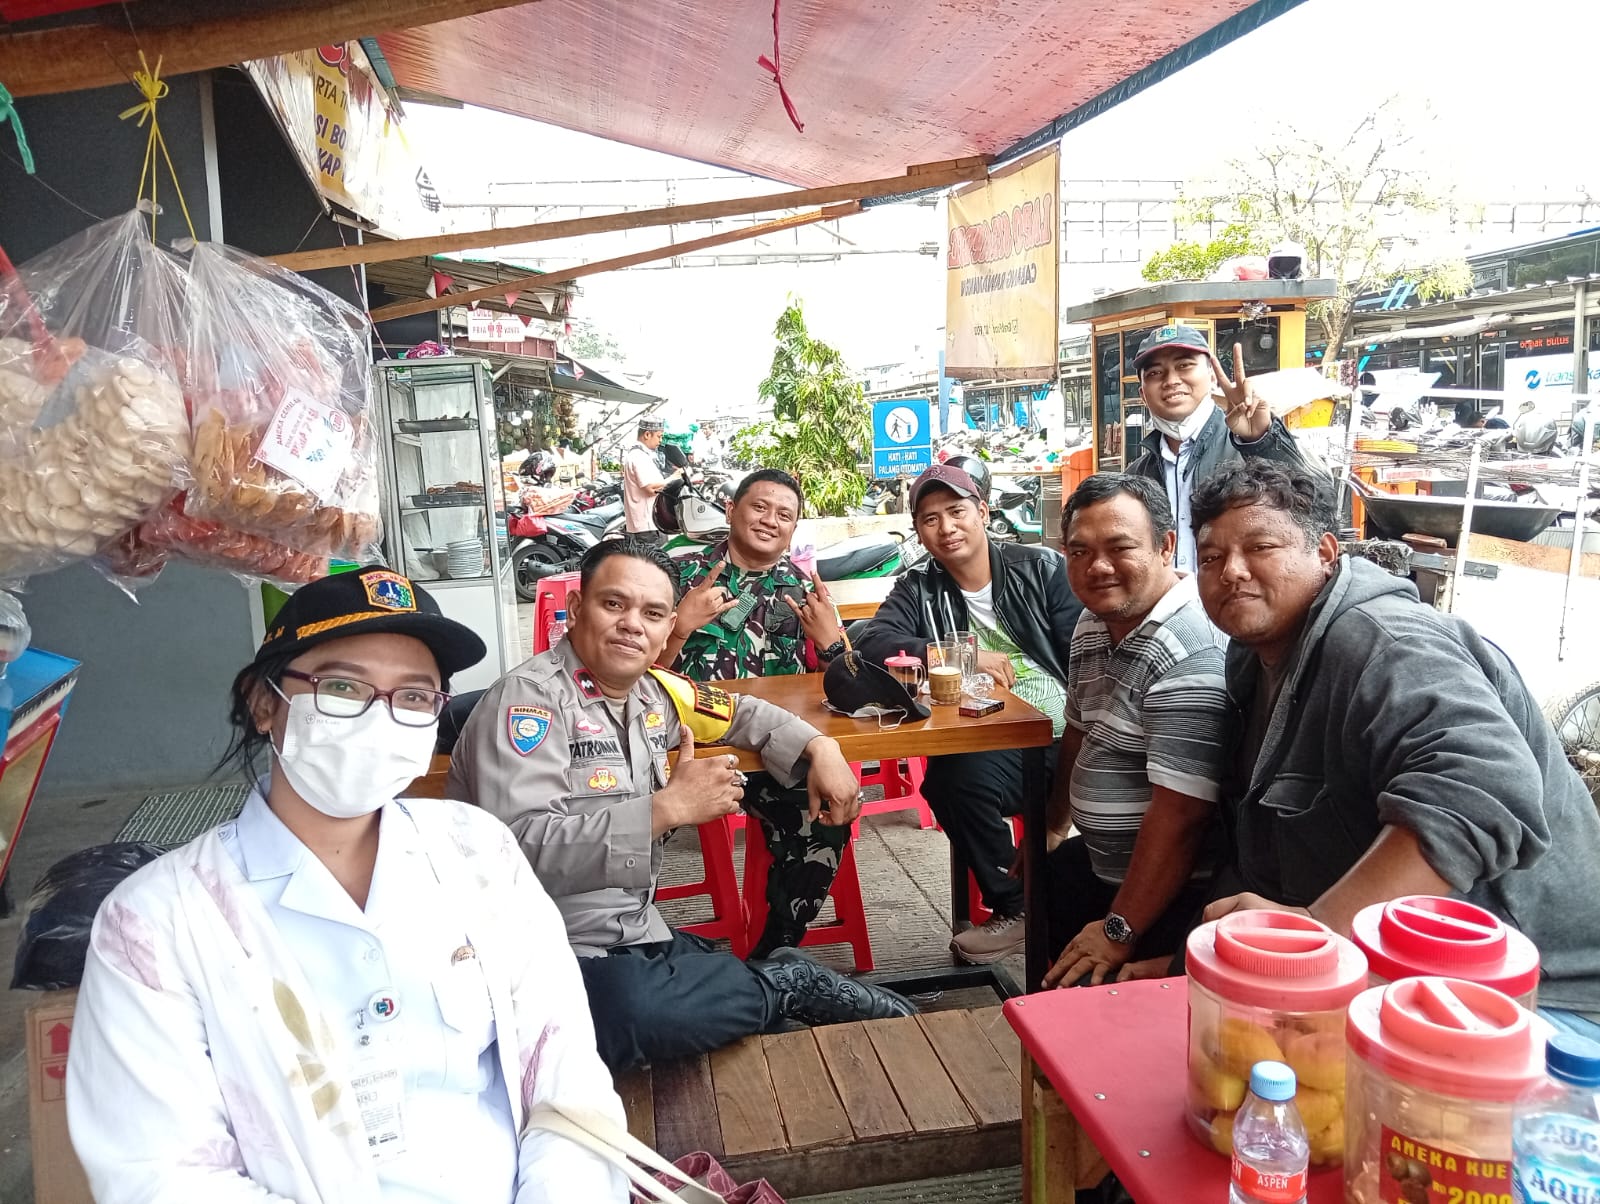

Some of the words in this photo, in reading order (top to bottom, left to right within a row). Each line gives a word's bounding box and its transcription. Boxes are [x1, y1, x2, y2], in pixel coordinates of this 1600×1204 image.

[887, 452, 900, 462] HATI
[904, 451, 917, 461] HATI
[878, 465, 899, 475] PALANG
[1391, 1135, 1457, 1172] ANEKA
[1466, 1162, 1507, 1180] KUE
[1257, 1175, 1288, 1189] ASPEN
